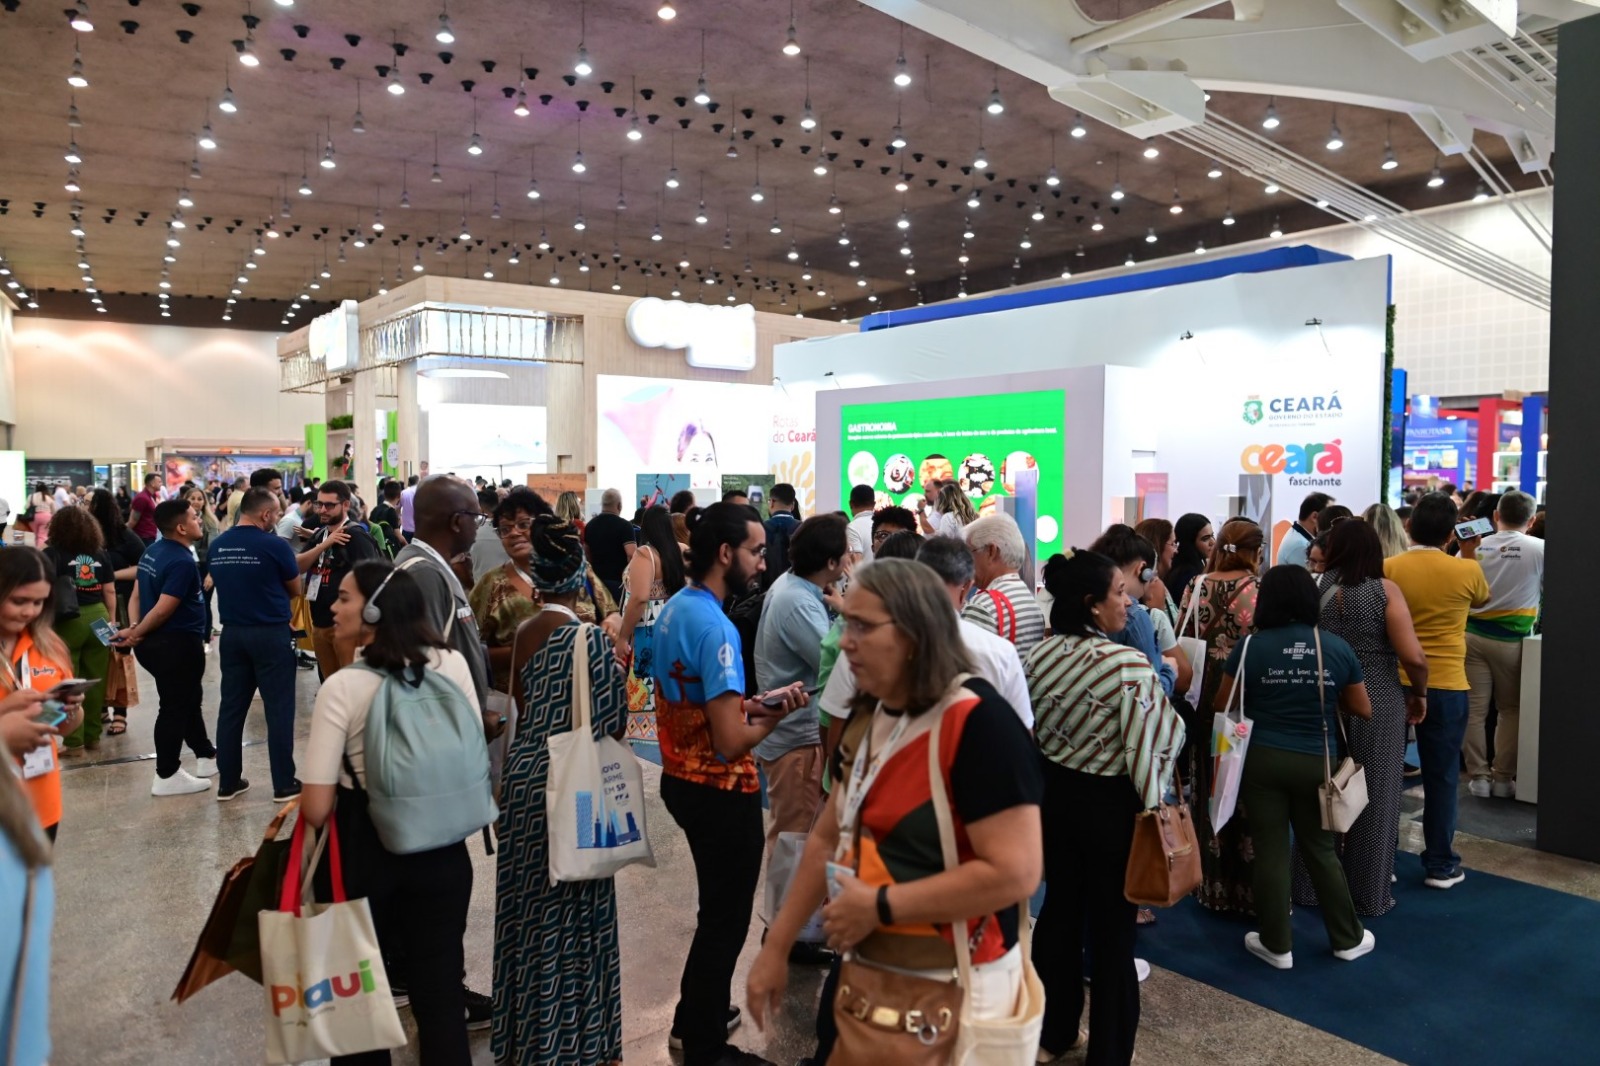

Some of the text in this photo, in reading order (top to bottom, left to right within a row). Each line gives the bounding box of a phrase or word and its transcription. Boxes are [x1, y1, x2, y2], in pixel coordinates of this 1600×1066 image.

[1269, 390, 1343, 413] CEARÁ
[1268, 413, 1302, 421] GOVERNO
[847, 421, 898, 433] GASTRONOMIA
[772, 428, 817, 443] do Ceará
[1240, 438, 1343, 475] ceará
[1289, 476, 1342, 487] fascinante
[1282, 647, 1317, 655] SEBRAE
[1268, 667, 1285, 676] Deixe
[616, 782, 626, 792] SP
[270, 958, 377, 1018] piauí
